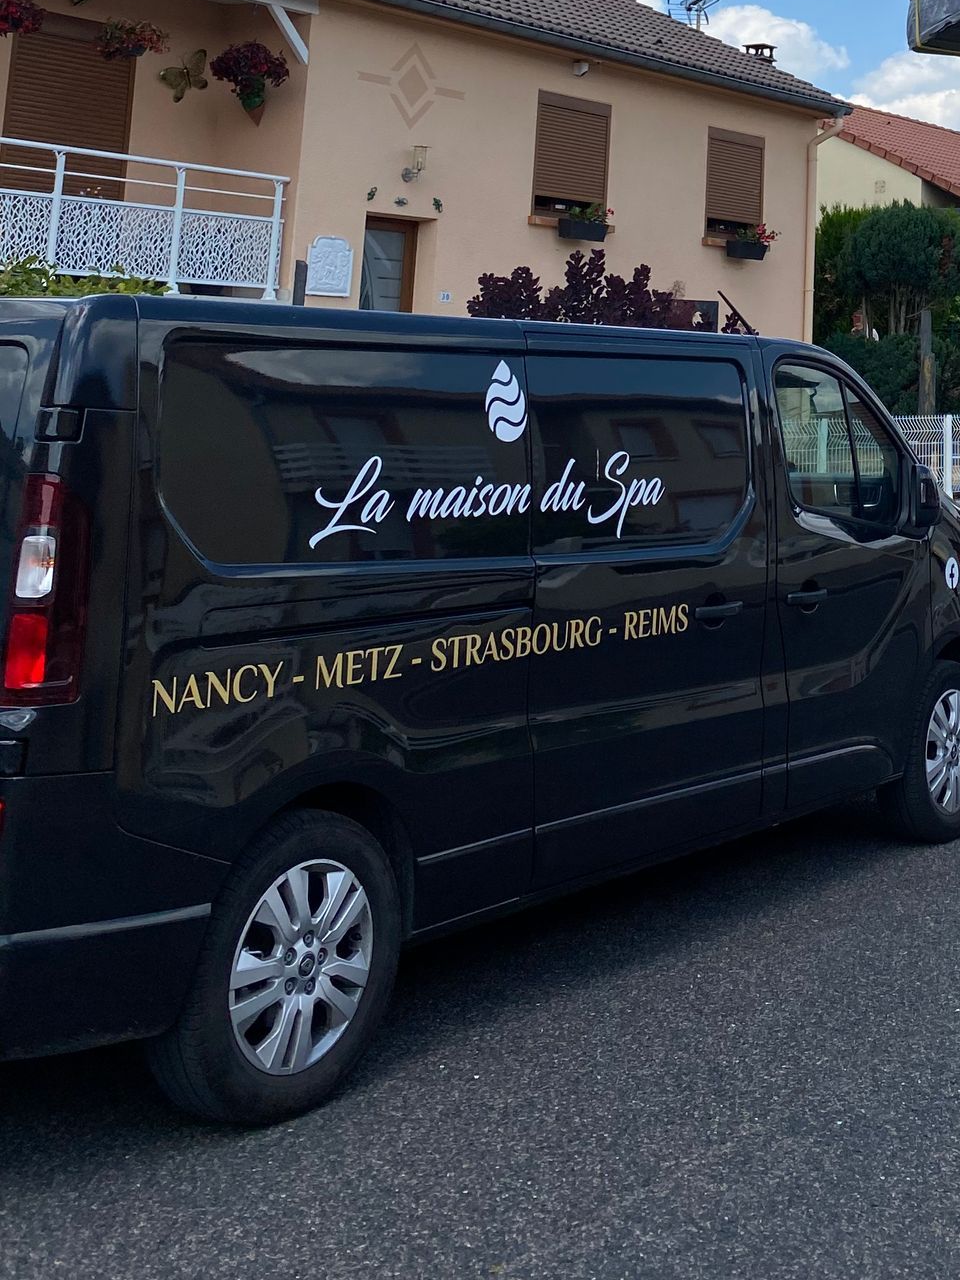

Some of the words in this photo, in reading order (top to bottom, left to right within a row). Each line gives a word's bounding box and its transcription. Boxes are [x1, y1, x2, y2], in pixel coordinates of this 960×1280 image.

[308, 455, 396, 550] La
[406, 475, 531, 522] maison
[539, 458, 586, 513] du
[587, 450, 666, 540] Spa
[151, 660, 284, 718] NANCY
[315, 643, 404, 691] METZ
[430, 615, 603, 672] STRASBOURG
[623, 603, 690, 642] REIMS
